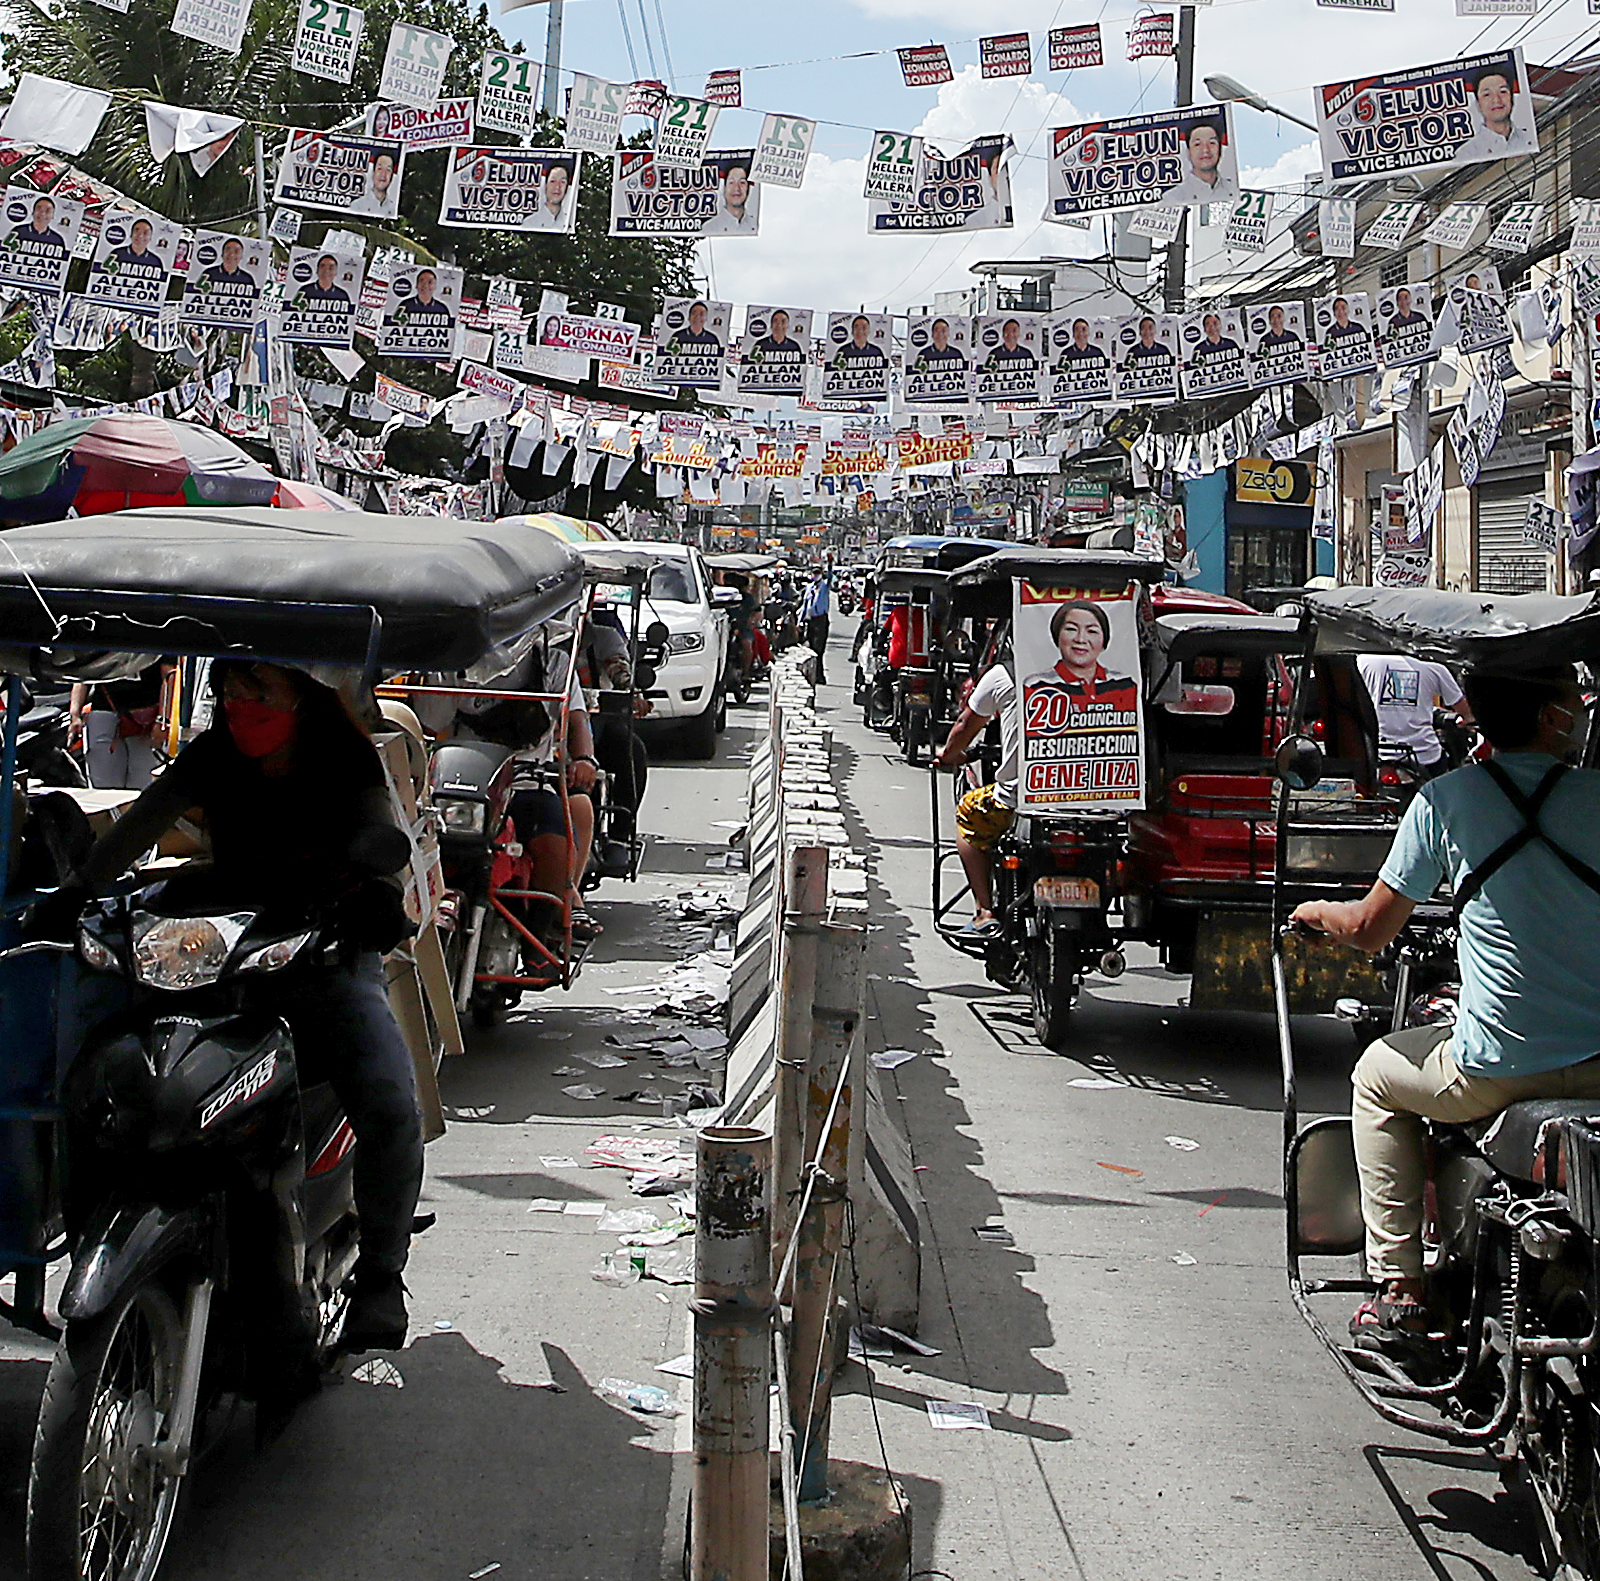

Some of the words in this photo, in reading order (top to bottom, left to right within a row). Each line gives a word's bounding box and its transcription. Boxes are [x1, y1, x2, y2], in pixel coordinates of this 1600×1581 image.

[1101, 126, 1181, 164] ELJUN
[1076, 187, 1162, 211] VICE-MAYOR
[19, 239, 64, 258] MAYOR
[0, 252, 62, 271] ALLAN
[661, 355, 718, 369] ALLAN
[1241, 469, 1288, 490] Zagu
[1027, 696, 1069, 732] 20
[1087, 703, 1114, 712] FOR
[1070, 710, 1137, 728] COUNCILOR
[1027, 734, 1138, 759] RESURRECCION
[1028, 764, 1089, 789] GENE
[1093, 762, 1139, 787] LIZA
